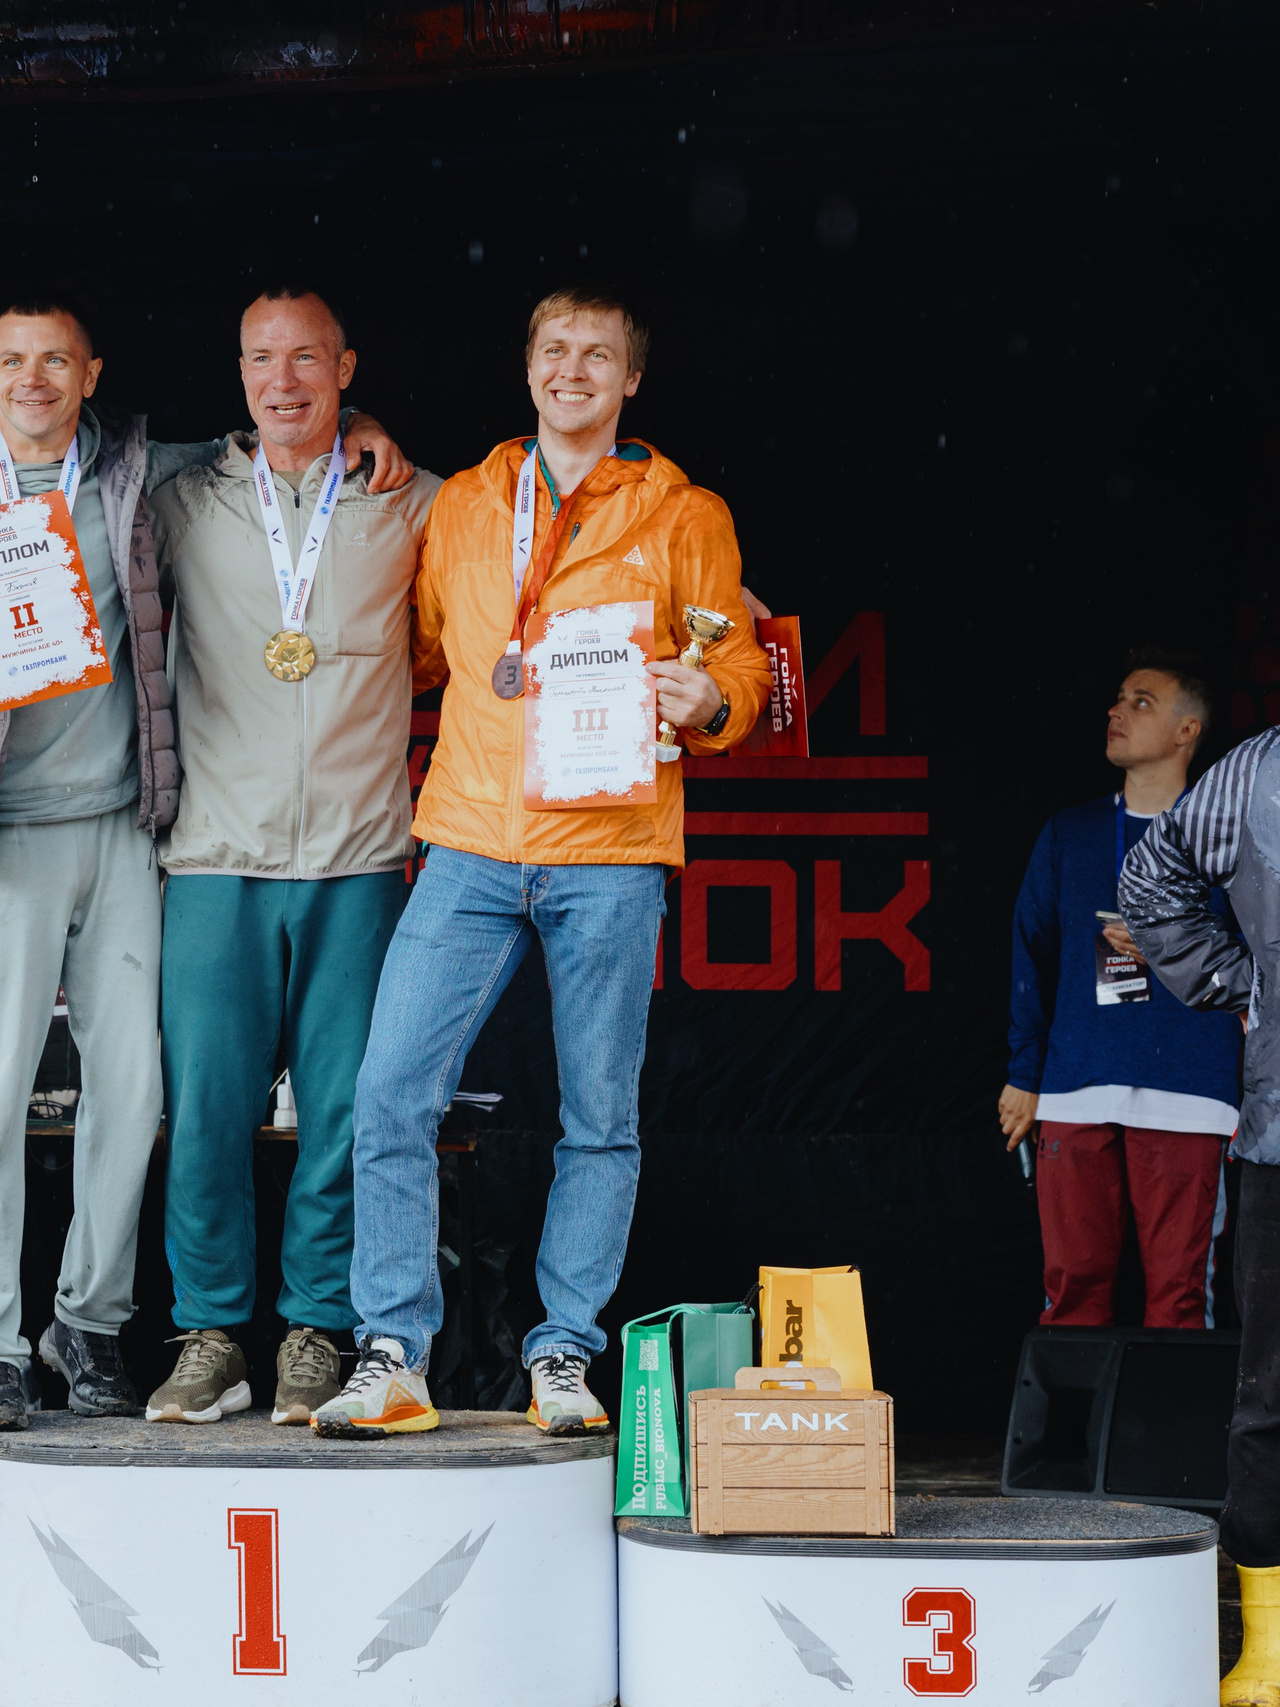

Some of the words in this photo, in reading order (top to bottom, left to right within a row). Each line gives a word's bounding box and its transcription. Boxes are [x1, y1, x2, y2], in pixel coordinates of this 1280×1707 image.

[264, 487, 272, 507] ГЕРОЕВ
[324, 472, 339, 505] ГАЗПРОМБАНК
[291, 599, 299, 620] ГОНКА
[296, 578, 306, 600] ГЕРОЕВ
[14, 626, 44, 640] МЕСТО
[574, 637, 601, 645] ГЕРОЕВ
[22, 654, 68, 672] ГАЗПРОМБАНК
[550, 649, 628, 670] ДИПЛОМ
[504, 665, 518, 685] 3
[765, 642, 783, 732] ГЕРОЕВ
[780, 648, 793, 726] ГОНКА
[576, 733, 604, 742] МЕСТО
[575, 765, 619, 775] ГАЗПРОМБАНК
[1105, 964, 1138, 974] ГЕРОЕВ
[1106, 956, 1135, 964] ГОНКА
[734, 1412, 849, 1431] TANK
[632, 1384, 648, 1510] ПОДПИШИСЬ
[654, 1387, 668, 1511] PUBLIC_BIONOVA
[228, 1508, 287, 1676] 1
[902, 1587, 977, 1697] 3
